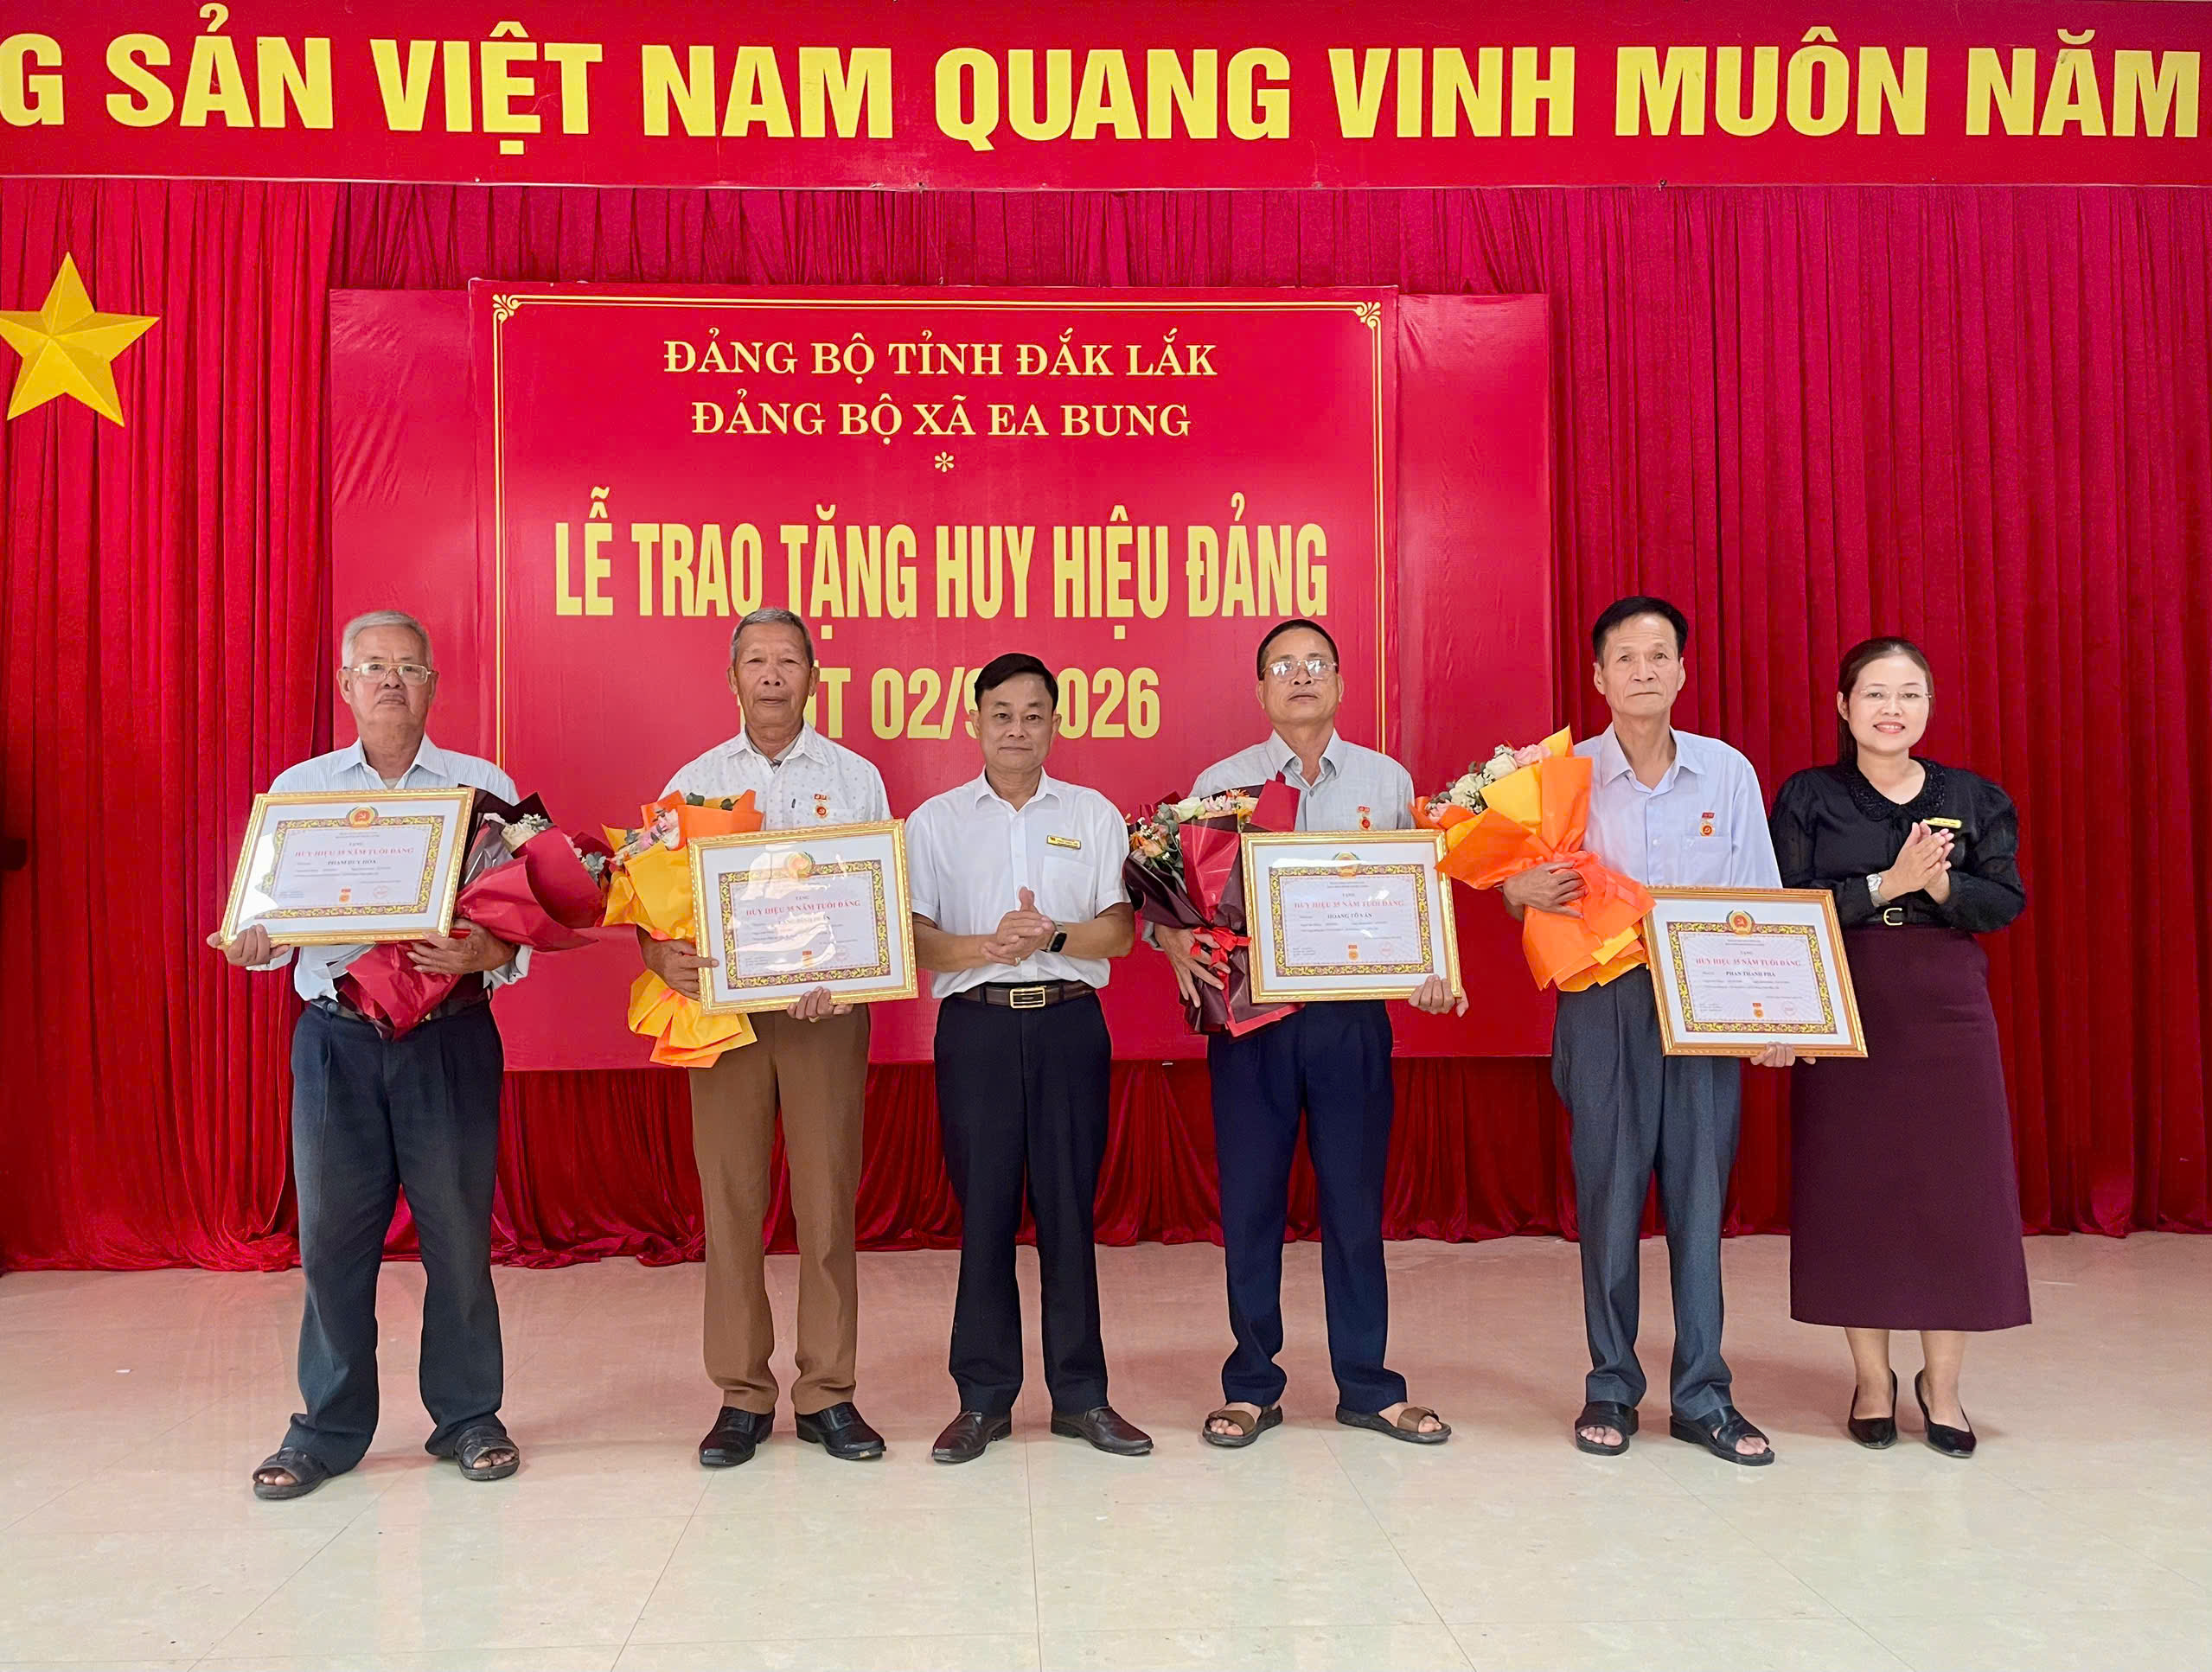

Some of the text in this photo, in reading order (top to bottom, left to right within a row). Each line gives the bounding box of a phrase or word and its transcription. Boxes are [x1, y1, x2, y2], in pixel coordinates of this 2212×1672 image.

[0, 3, 2201, 155] G SẢN VIỆT NAM QUANG VINH MUÔN NĂM
[663, 327, 1218, 385] ĐẢNG BỘ TỈNH ĐẮK LẮK
[691, 388, 1192, 445] ĐẢNG BỘ XÃ EA BUNG
[555, 486, 1327, 641] LỄ TRAO TẶNG HUY HIỆU ĐẢNG
